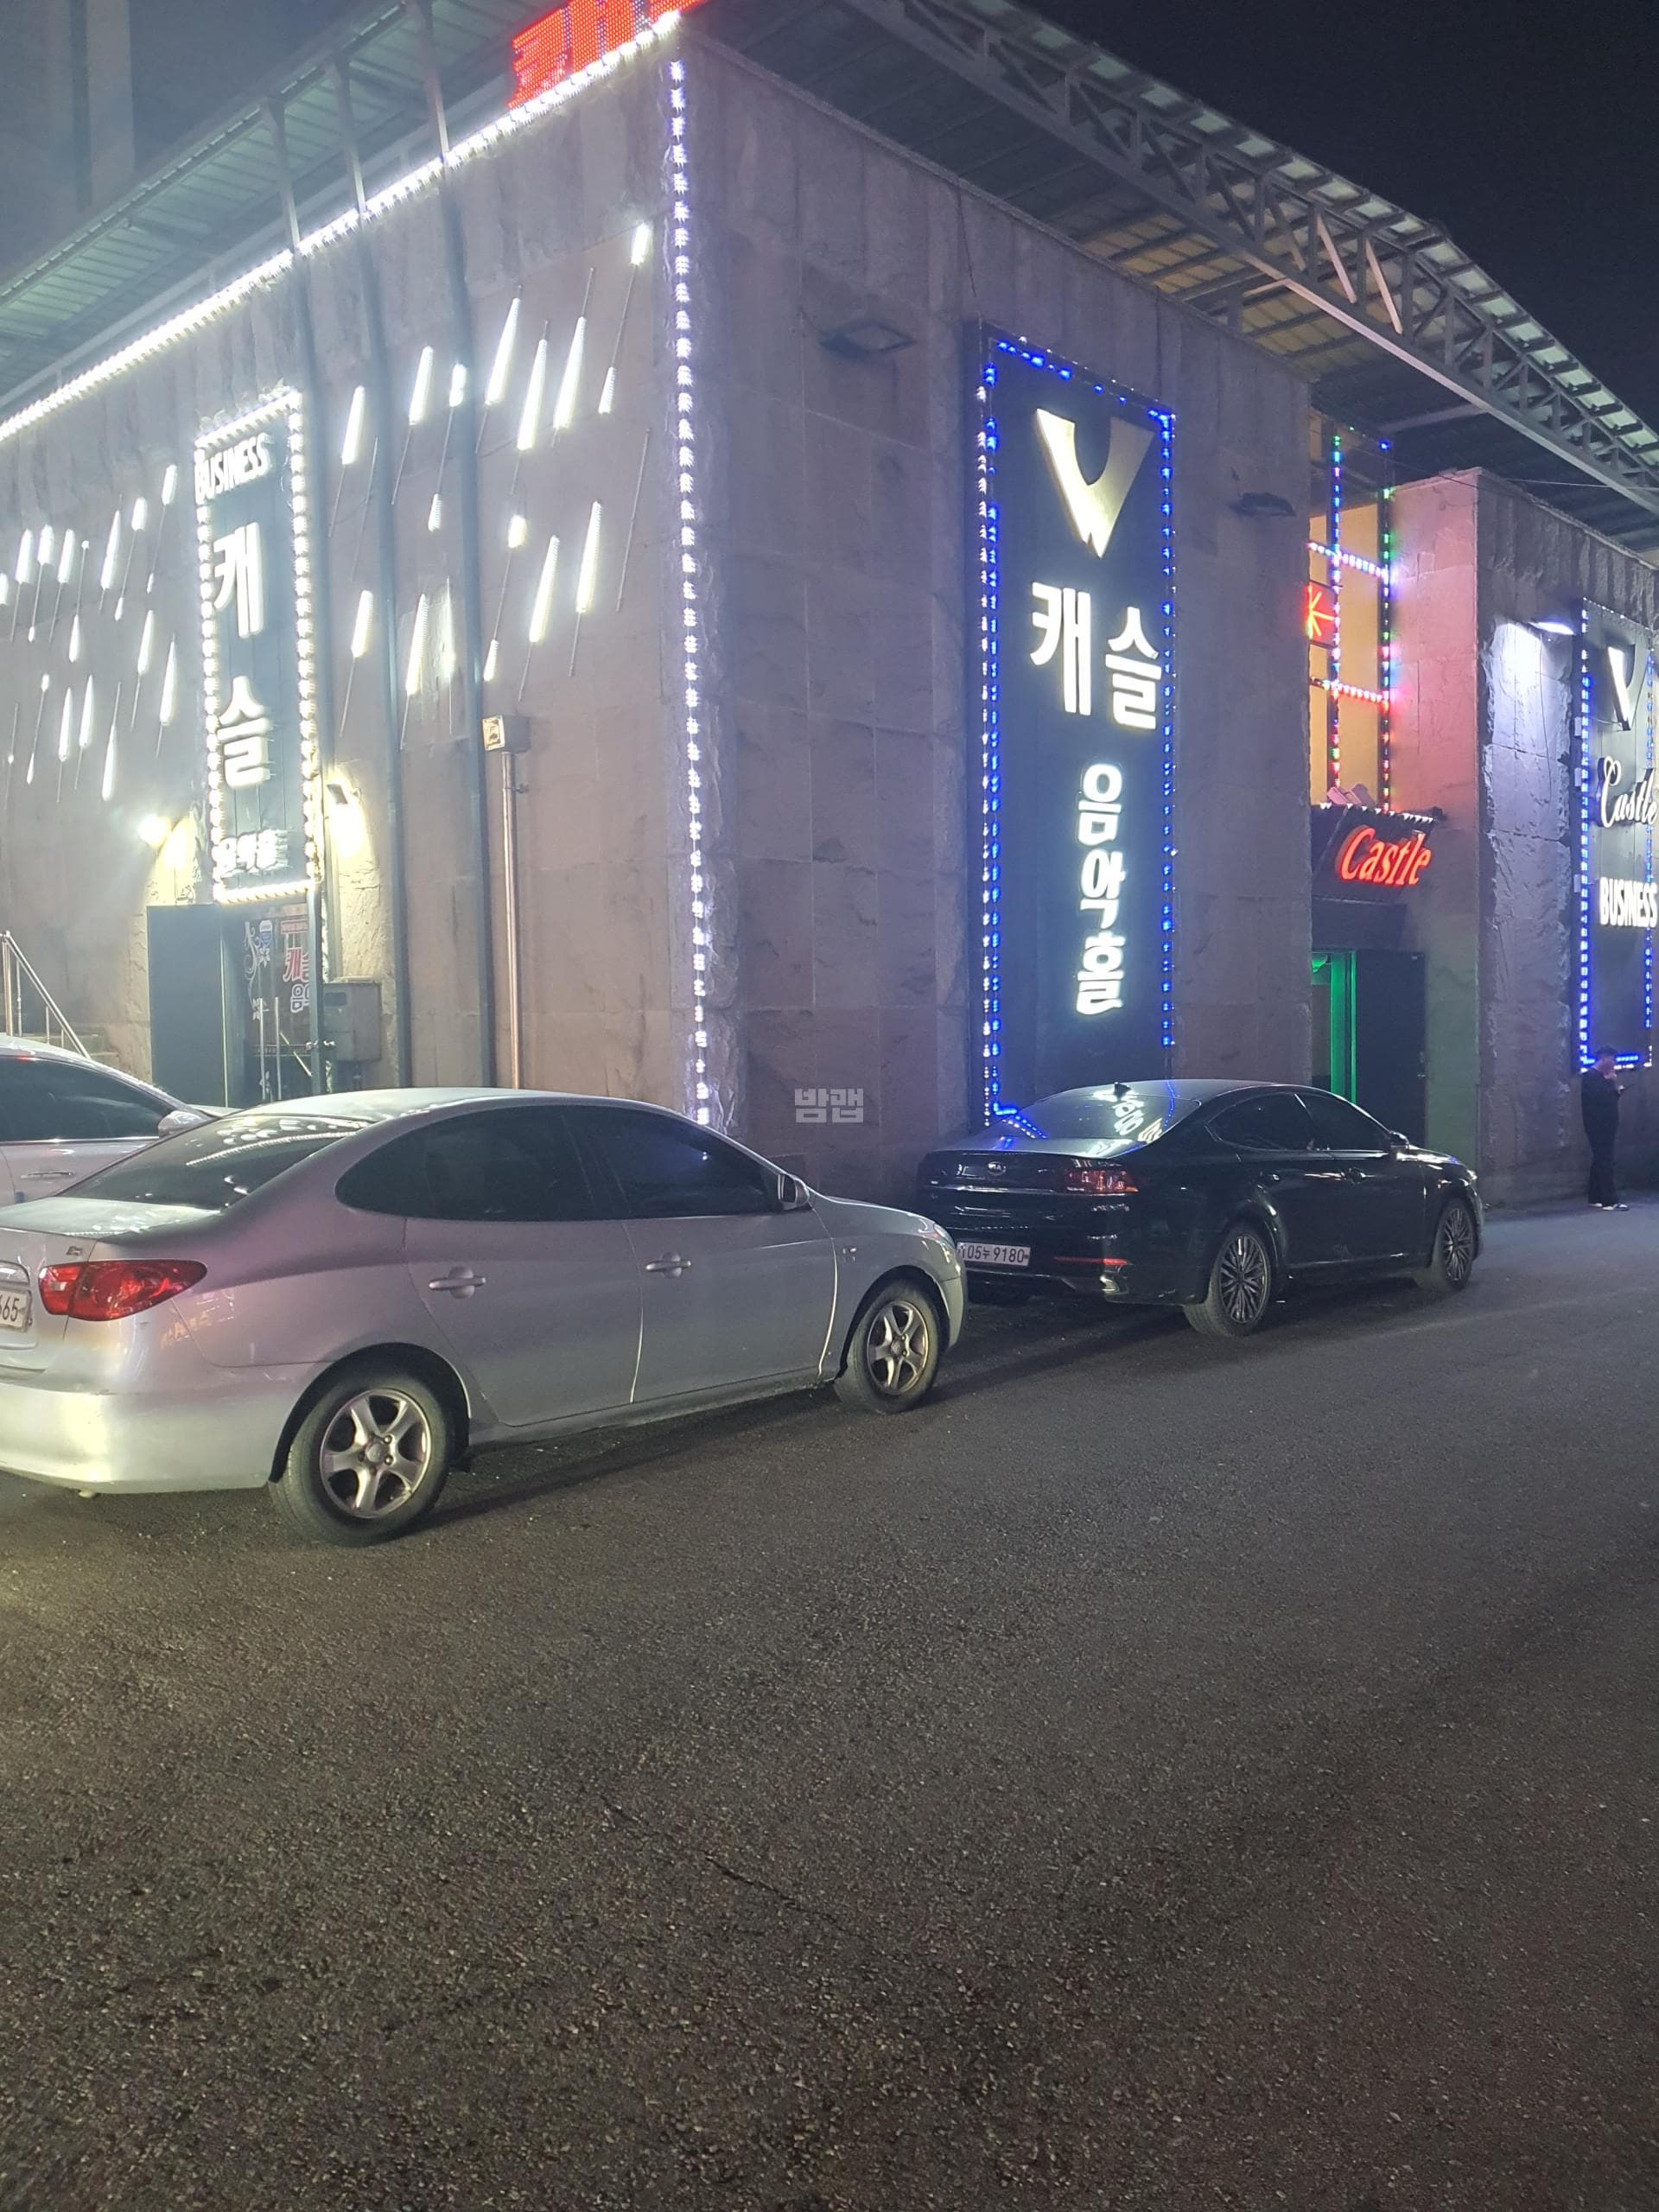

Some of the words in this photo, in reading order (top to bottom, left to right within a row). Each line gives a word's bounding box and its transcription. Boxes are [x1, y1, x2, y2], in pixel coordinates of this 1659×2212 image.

[213, 521, 270, 790] 캐슬
[1030, 581, 1162, 731] 캐슬
[1600, 755, 1658, 828] Castle
[1077, 763, 1127, 1015] 음악홀
[1338, 826, 1432, 887] Castle
[1599, 877, 1658, 928] BUSINESS
[0, 1295, 20, 1323] 65
